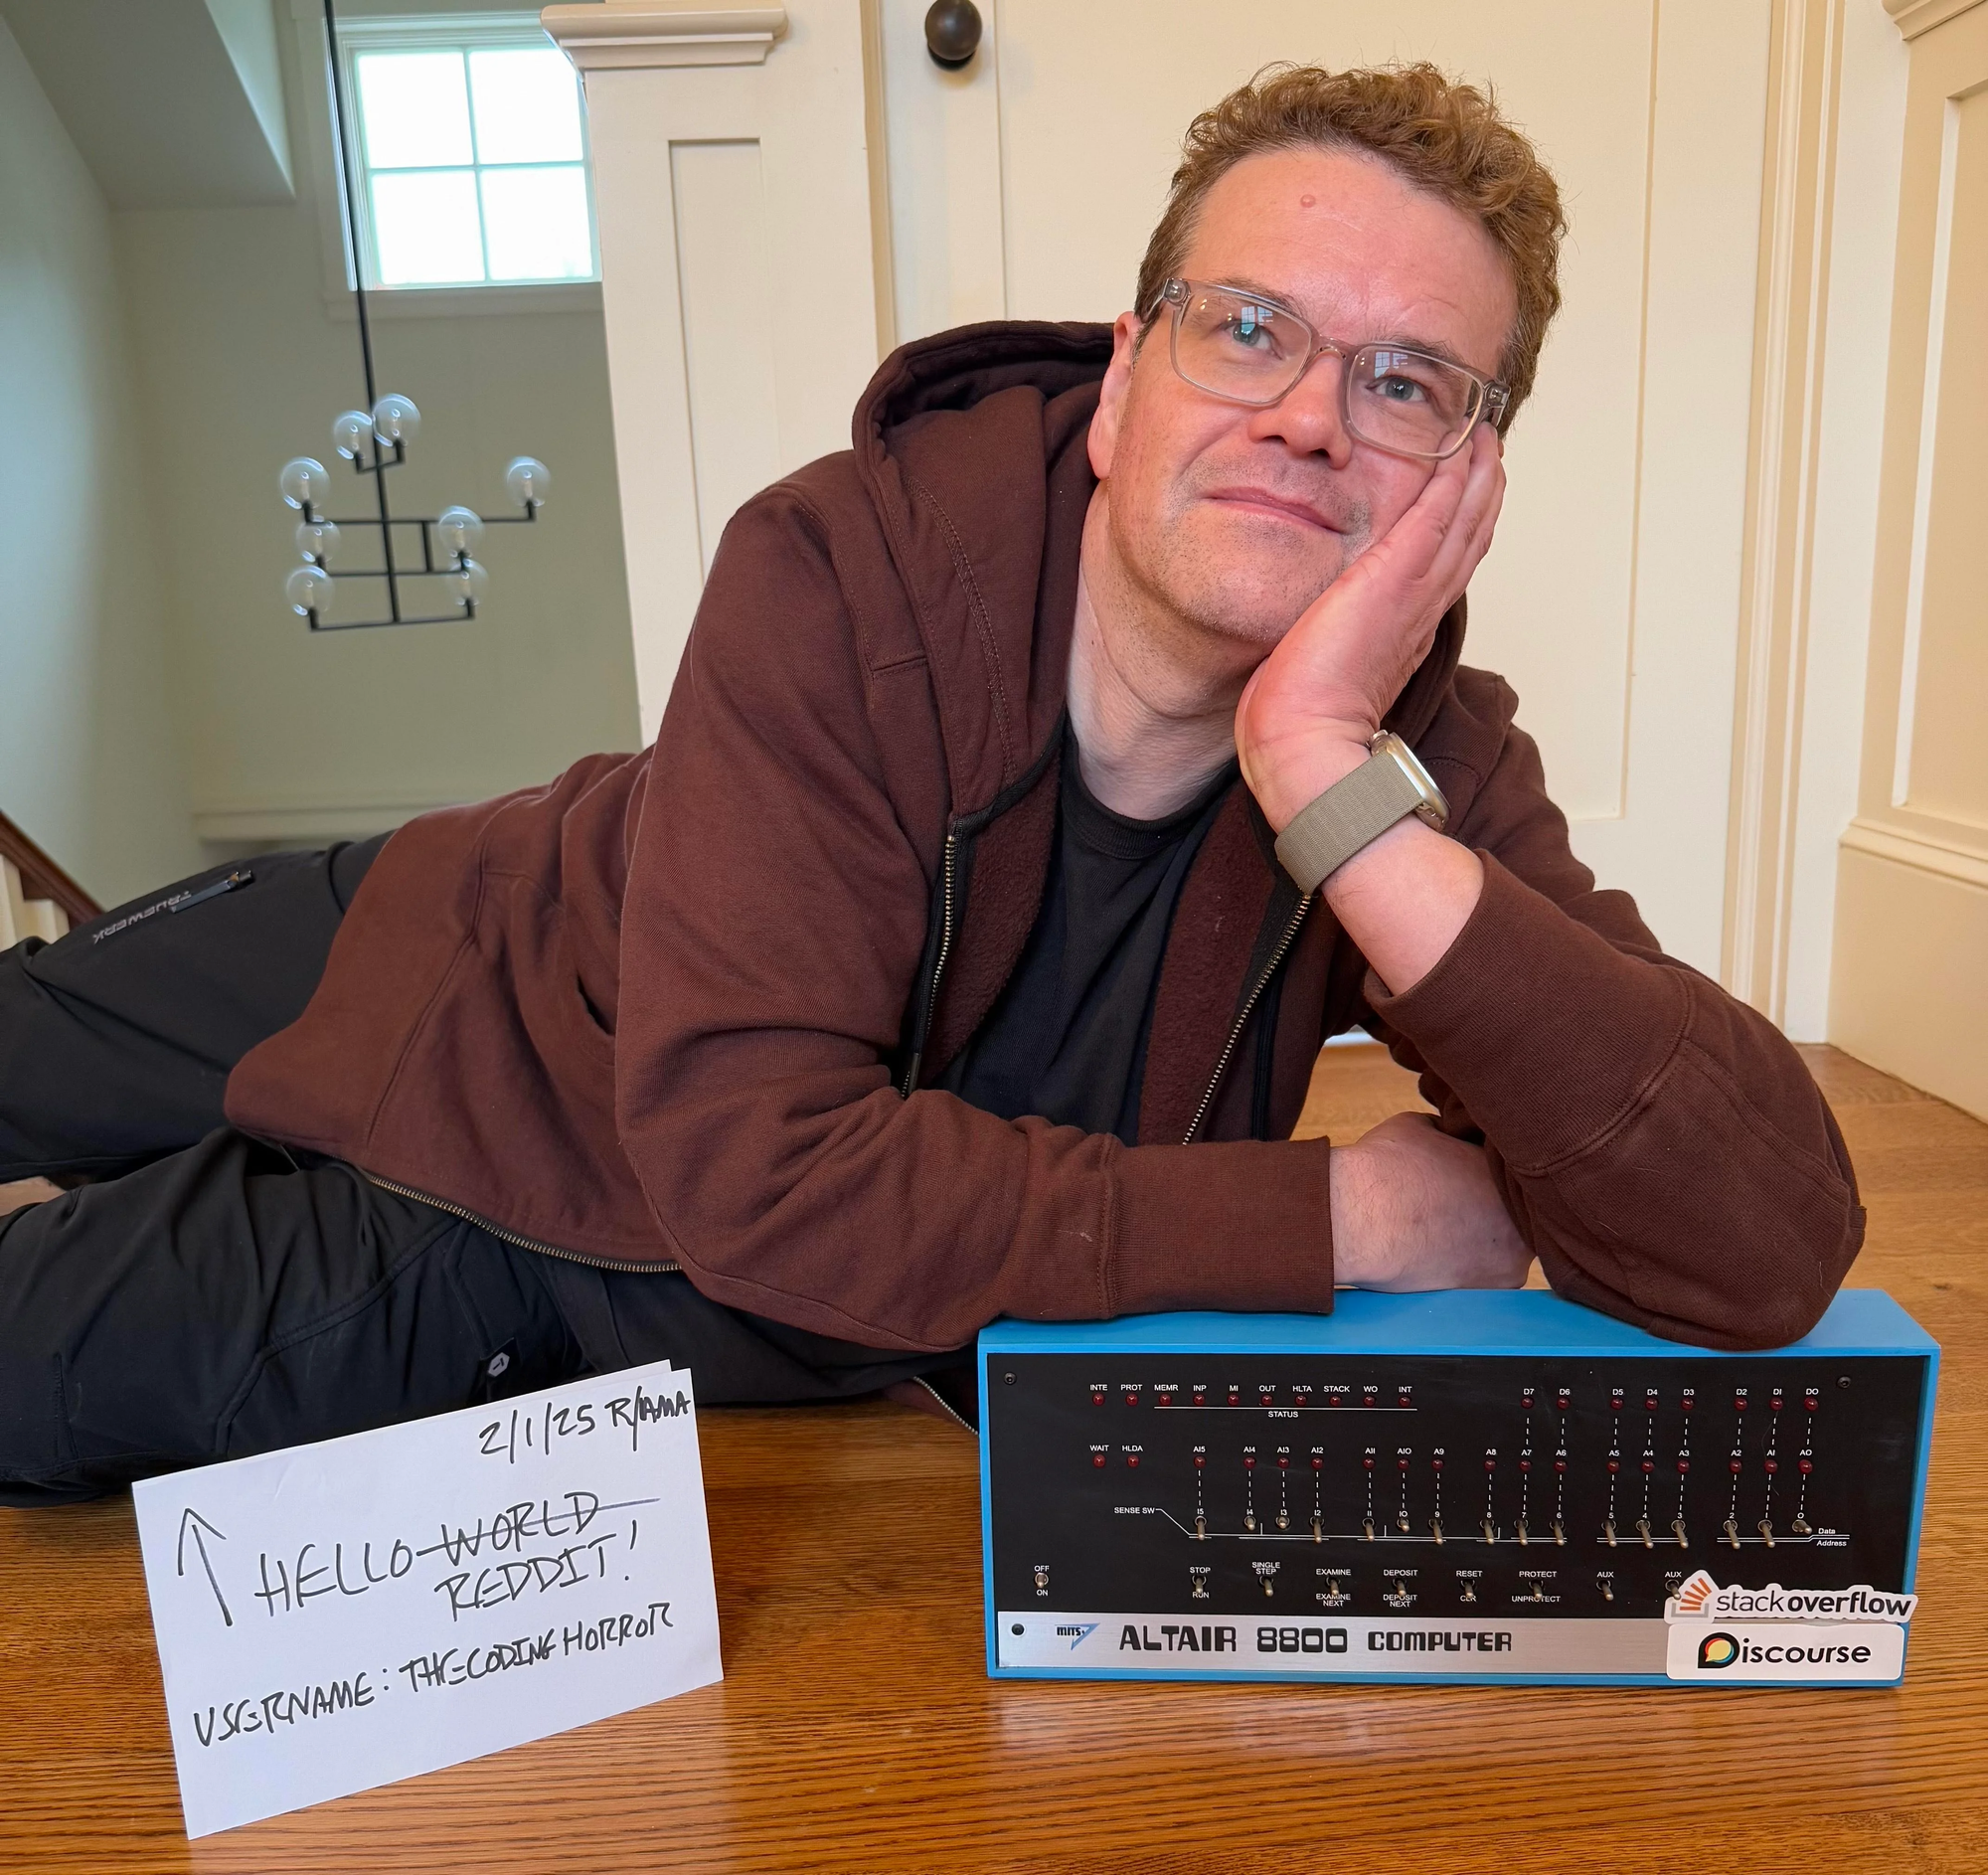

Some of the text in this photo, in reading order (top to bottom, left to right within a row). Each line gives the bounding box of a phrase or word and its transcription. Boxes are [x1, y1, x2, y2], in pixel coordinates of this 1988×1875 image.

[478, 1402, 595, 1464] 2/1/25
[1267, 1410, 1299, 1419] STATUS
[254, 1538, 413, 1617] HELLO
[434, 1520, 637, 1621] REDDIT!
[1119, 1624, 1237, 1652] ALTAIR
[1256, 1626, 1347, 1653] 8800
